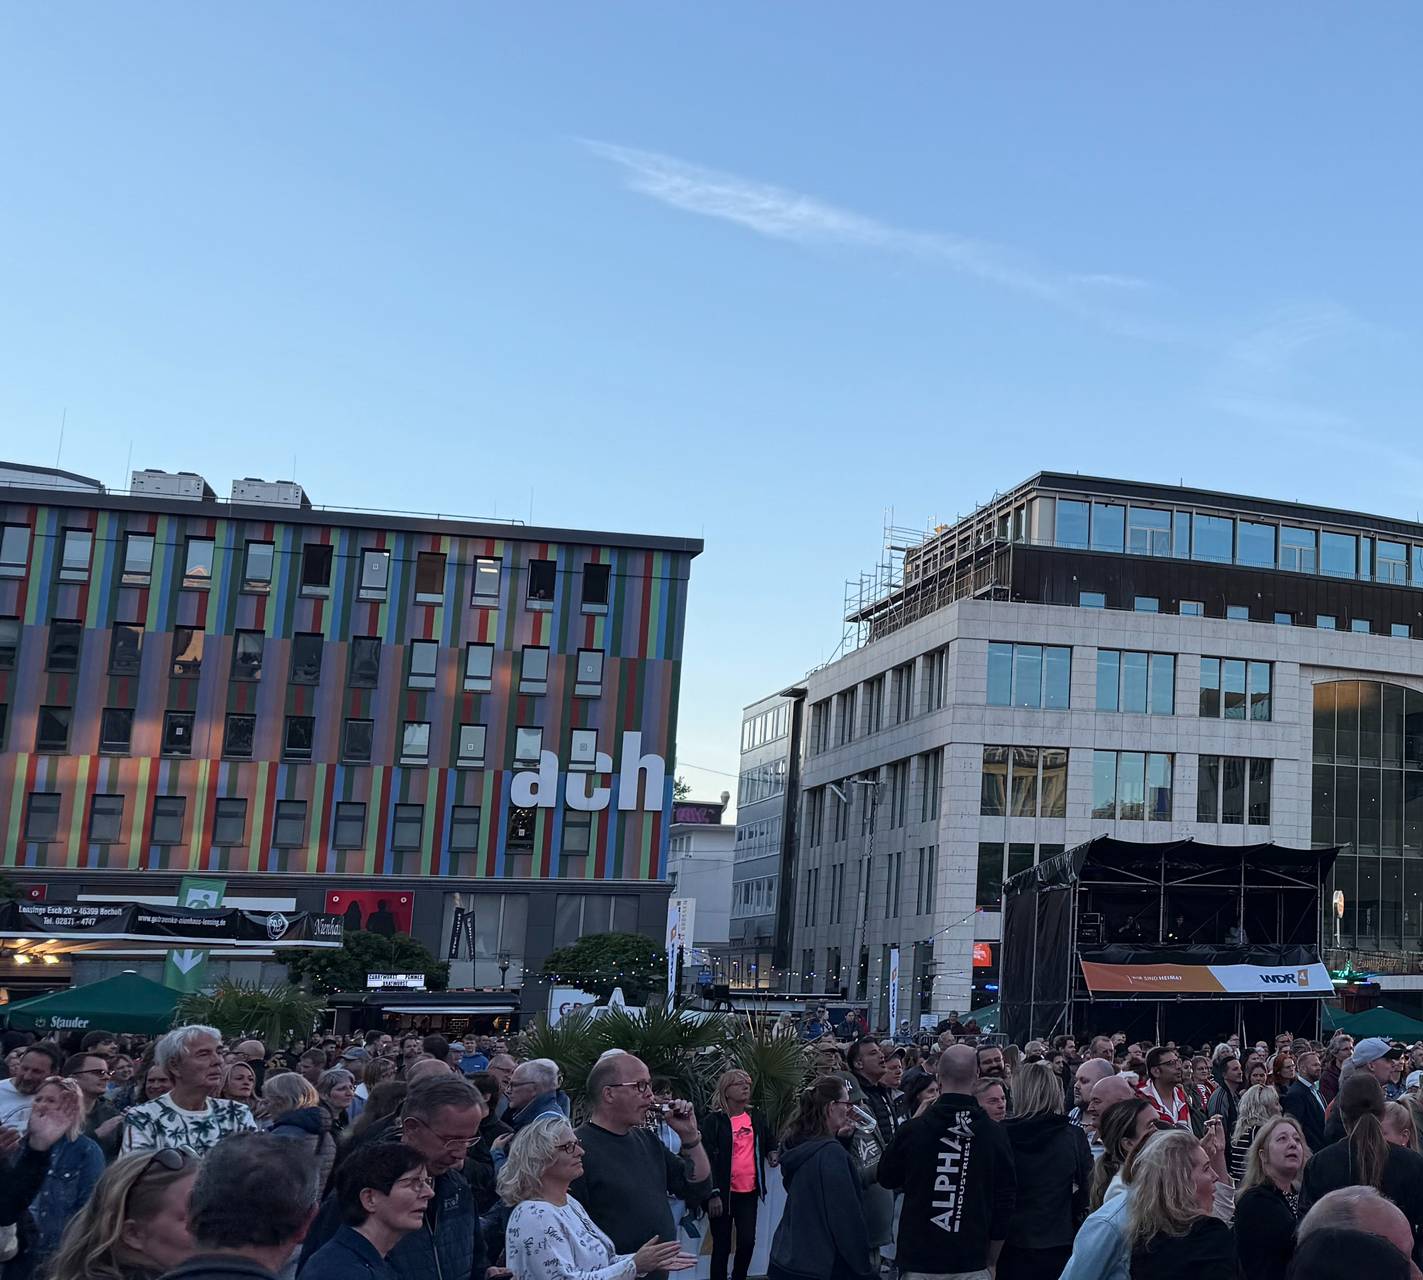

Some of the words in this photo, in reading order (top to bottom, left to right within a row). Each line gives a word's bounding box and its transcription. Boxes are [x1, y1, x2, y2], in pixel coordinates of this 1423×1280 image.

[1259, 973, 1297, 984] WDR
[50, 1015, 89, 1029] Stauder
[930, 1134, 963, 1233] ALPHA
[955, 1141, 972, 1220] INDUSTRIES
